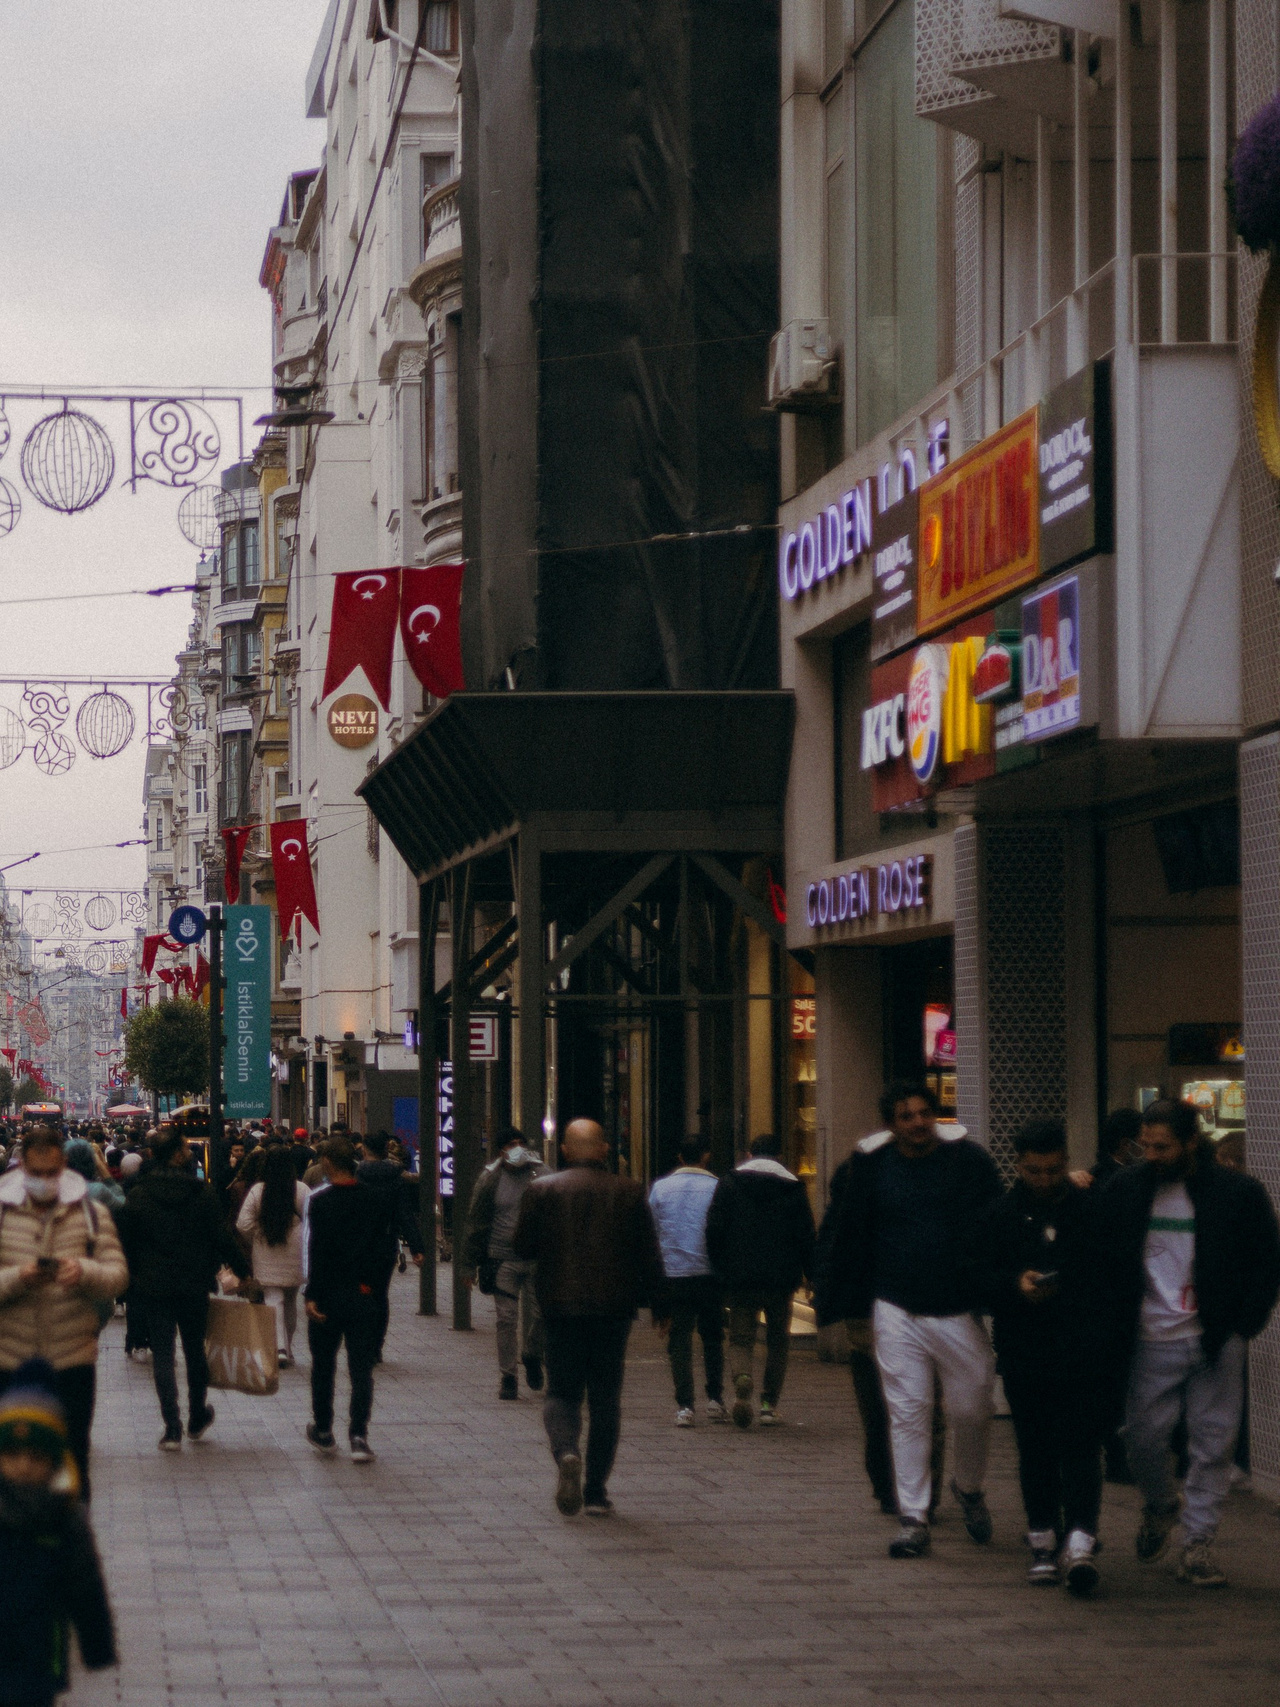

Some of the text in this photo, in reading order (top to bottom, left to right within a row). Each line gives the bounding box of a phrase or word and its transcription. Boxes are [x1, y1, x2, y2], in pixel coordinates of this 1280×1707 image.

[781, 477, 872, 600] GOLDEN
[331, 711, 377, 724] NEVI
[334, 726, 374, 735] HOTELS
[861, 693, 906, 769] KFC
[807, 855, 926, 928] GOLDEN ROSE
[230, 1101, 265, 1109] istiklal.ist
